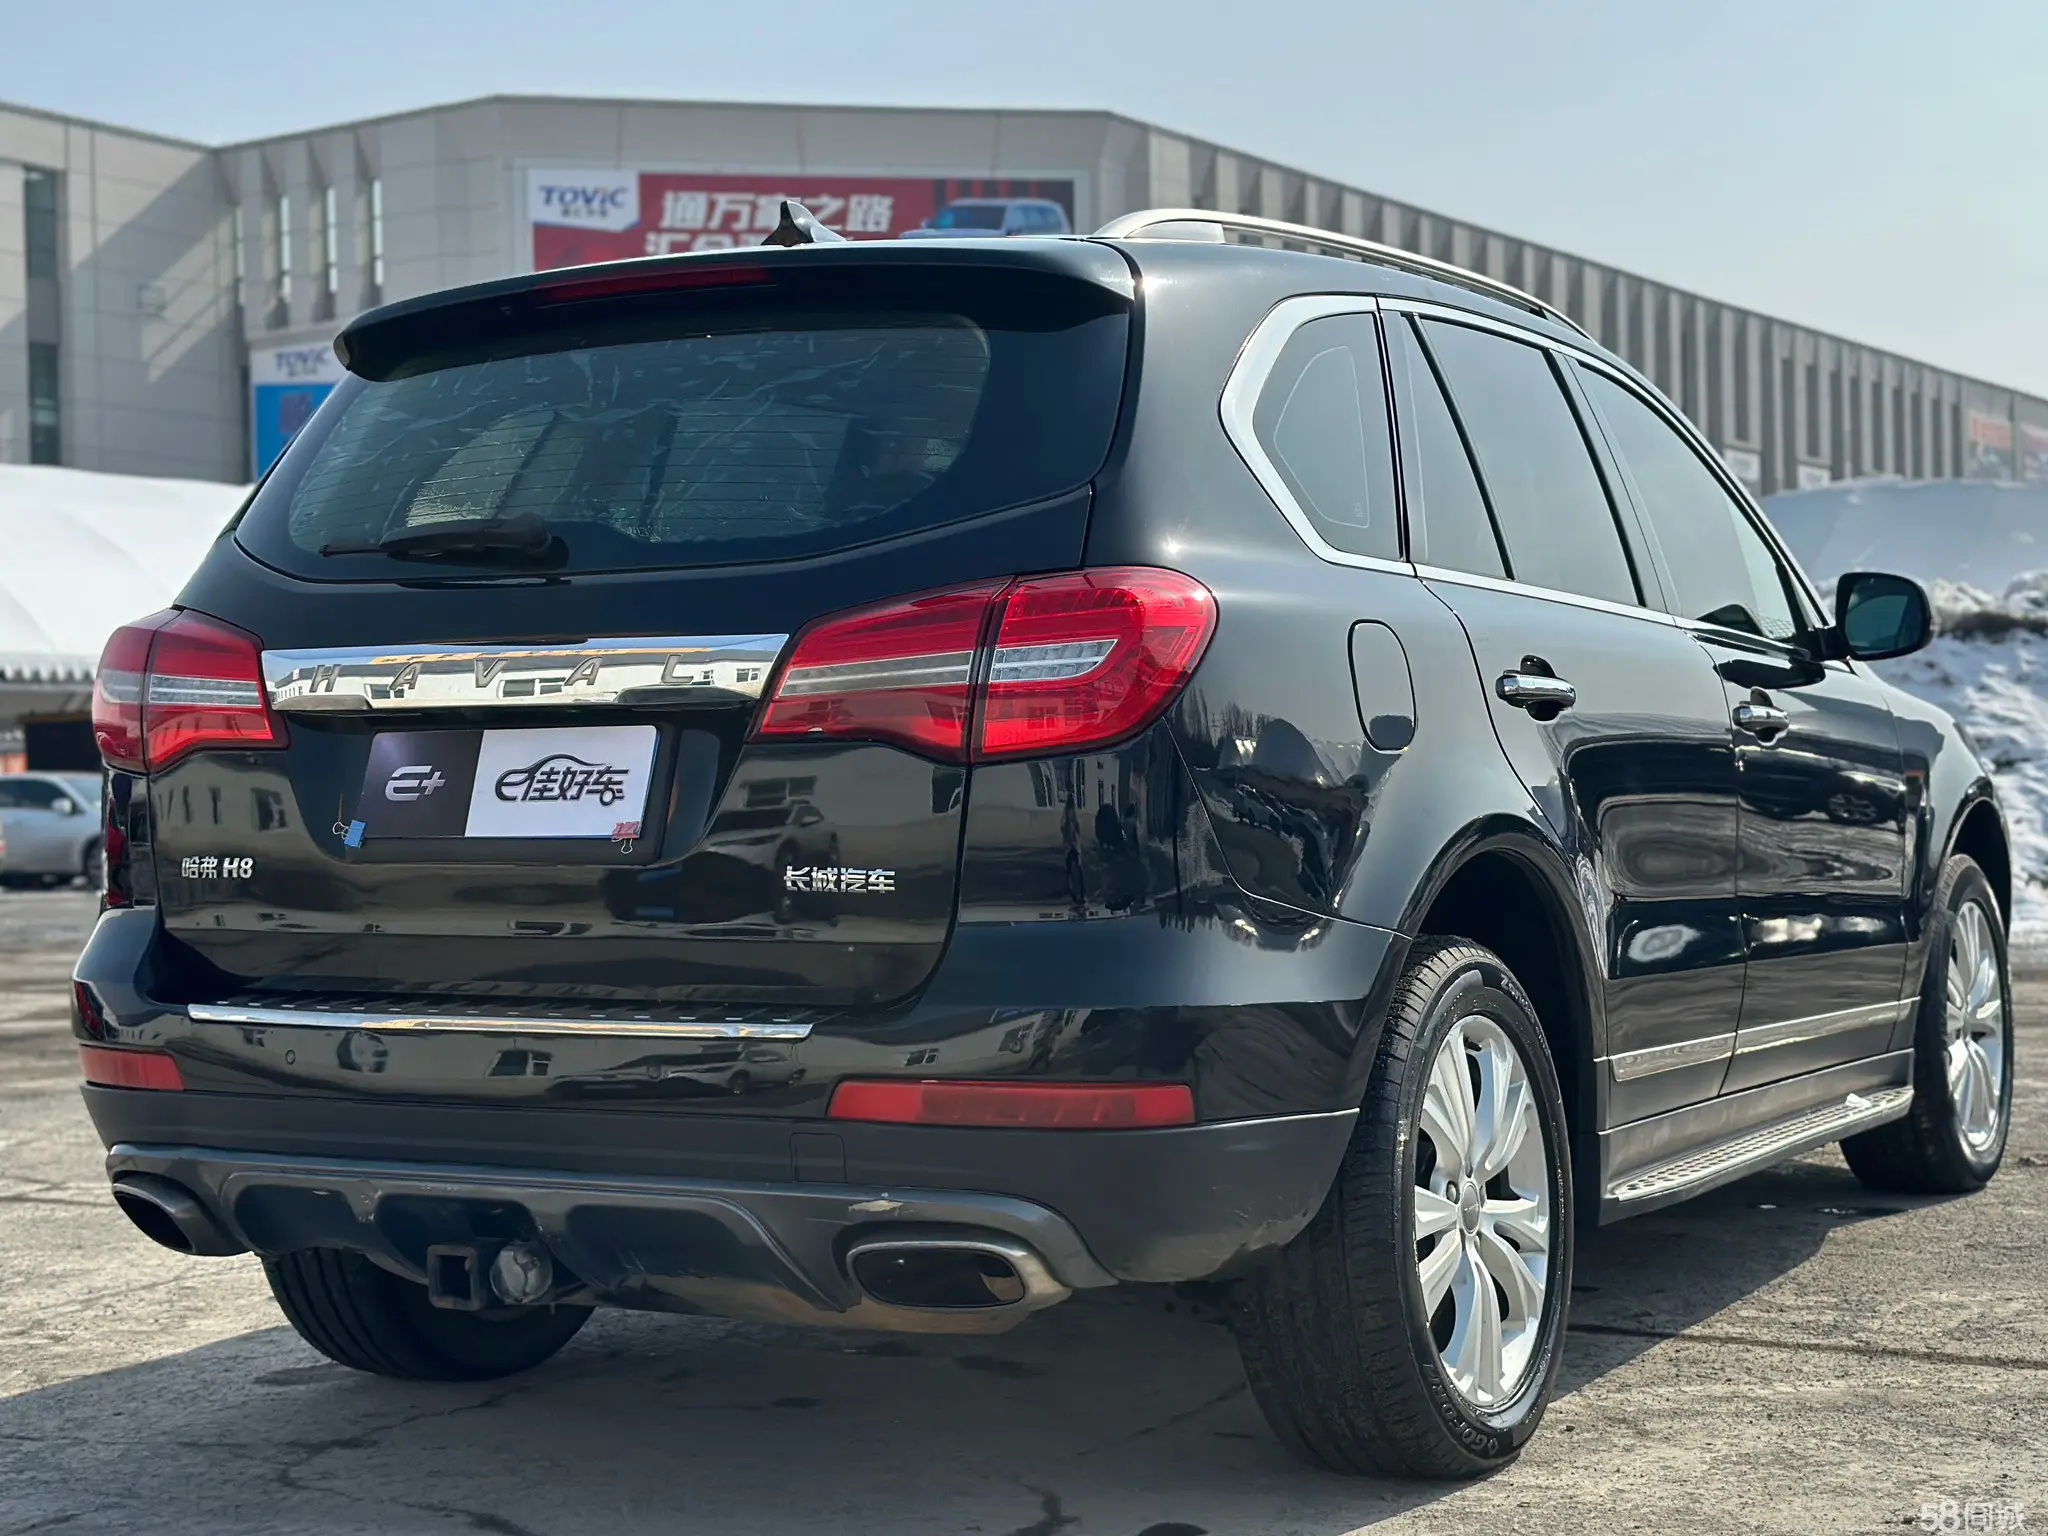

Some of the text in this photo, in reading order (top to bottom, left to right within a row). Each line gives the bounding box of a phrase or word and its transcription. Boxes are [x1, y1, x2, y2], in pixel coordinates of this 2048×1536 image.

[308, 653, 696, 693] HAVAL
[181, 856, 254, 878] 哈弗 H8
[784, 865, 896, 893] 长城汽车
